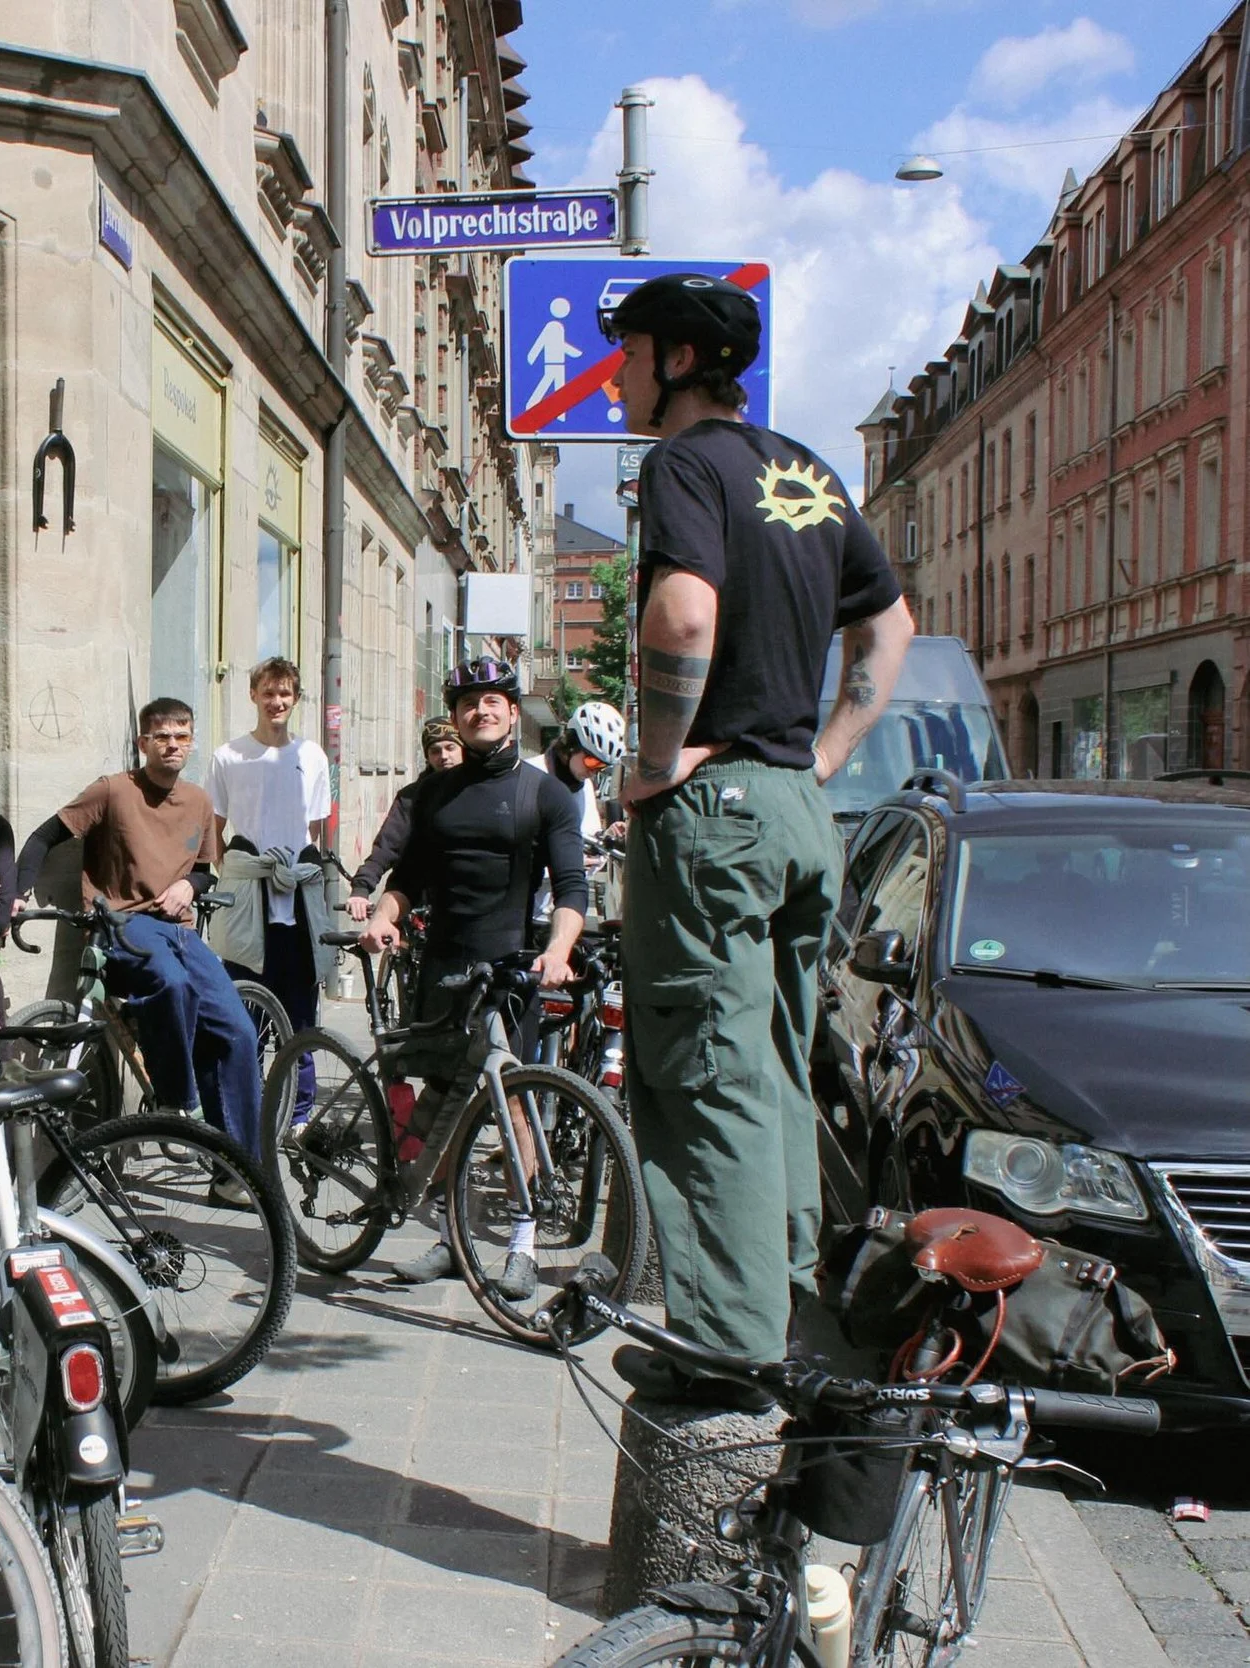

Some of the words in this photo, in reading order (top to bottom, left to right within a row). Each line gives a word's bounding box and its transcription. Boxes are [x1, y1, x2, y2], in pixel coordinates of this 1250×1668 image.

[389, 200, 598, 245] Volprechtstraße
[585, 1294, 632, 1328] SURLY
[876, 1387, 931, 1401] SURLY
